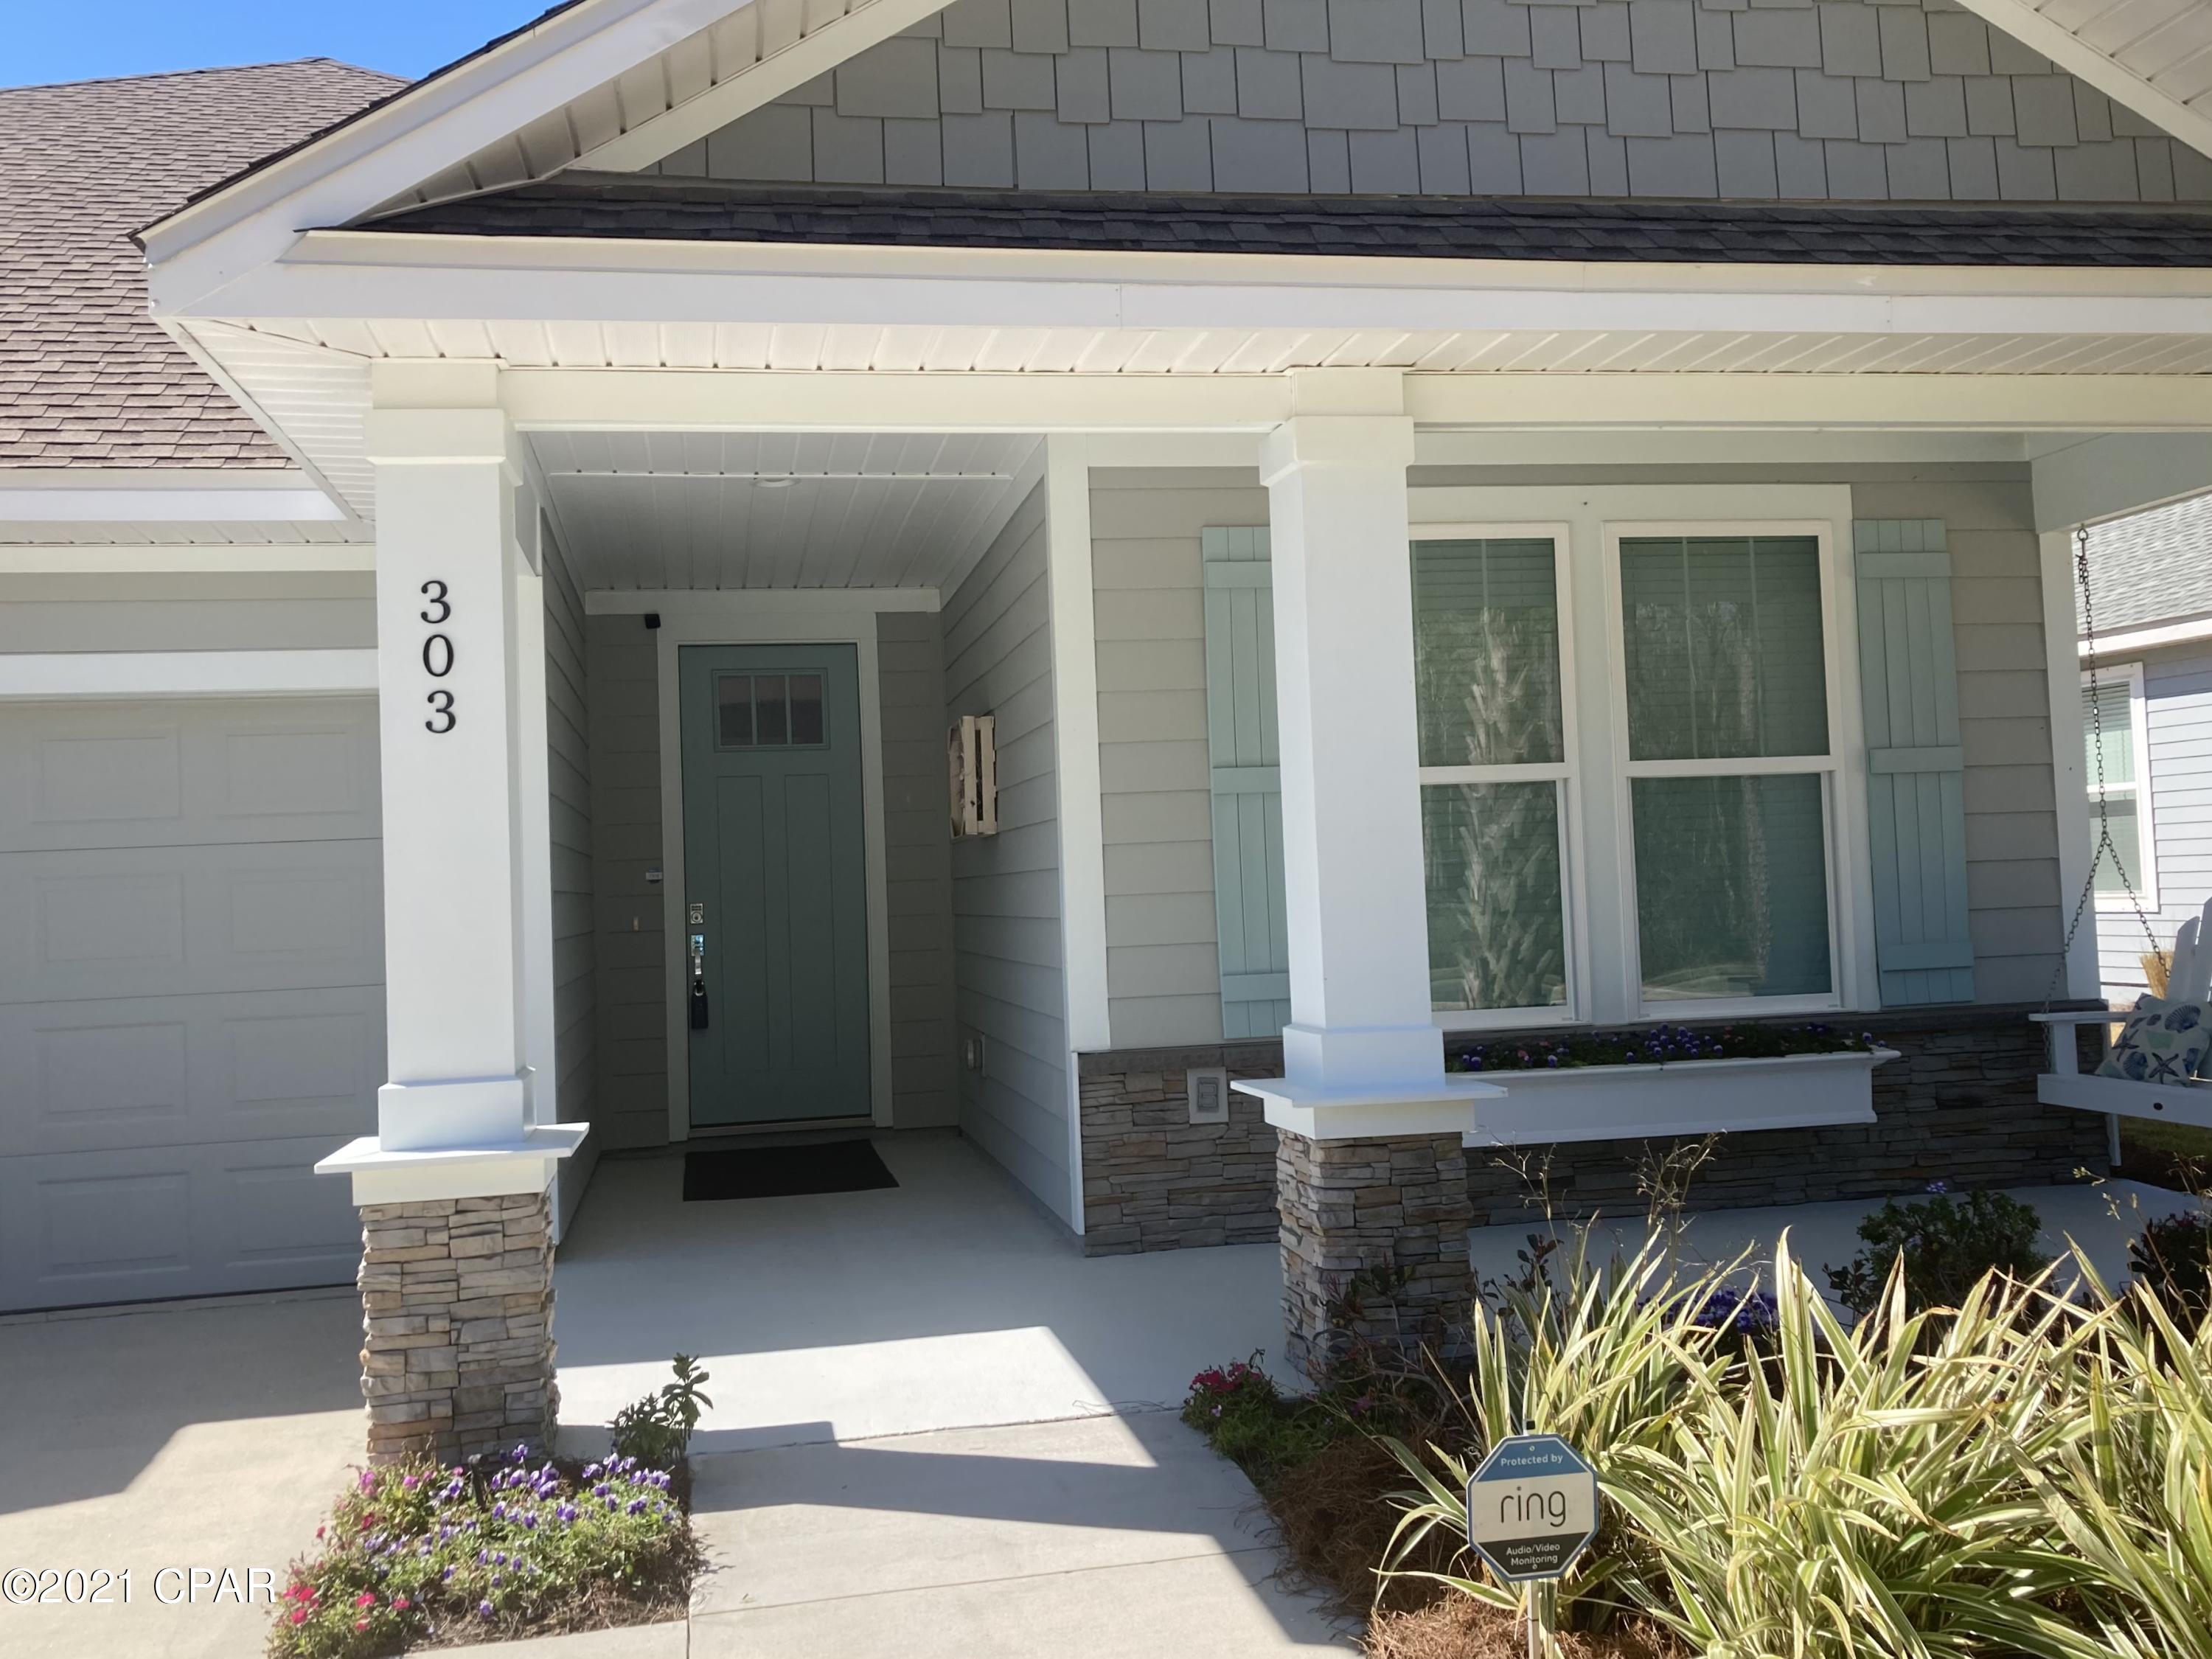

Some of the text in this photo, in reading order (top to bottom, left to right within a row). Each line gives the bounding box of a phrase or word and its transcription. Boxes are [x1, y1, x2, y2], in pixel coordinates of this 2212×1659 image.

[420, 580, 456, 734] 303
[1500, 1453, 1563, 1467] Protected by
[1500, 1486, 1566, 1528] ring
[1506, 1543, 1560, 1556] Audio/Video
[1511, 1554, 1558, 1566] Monitoring
